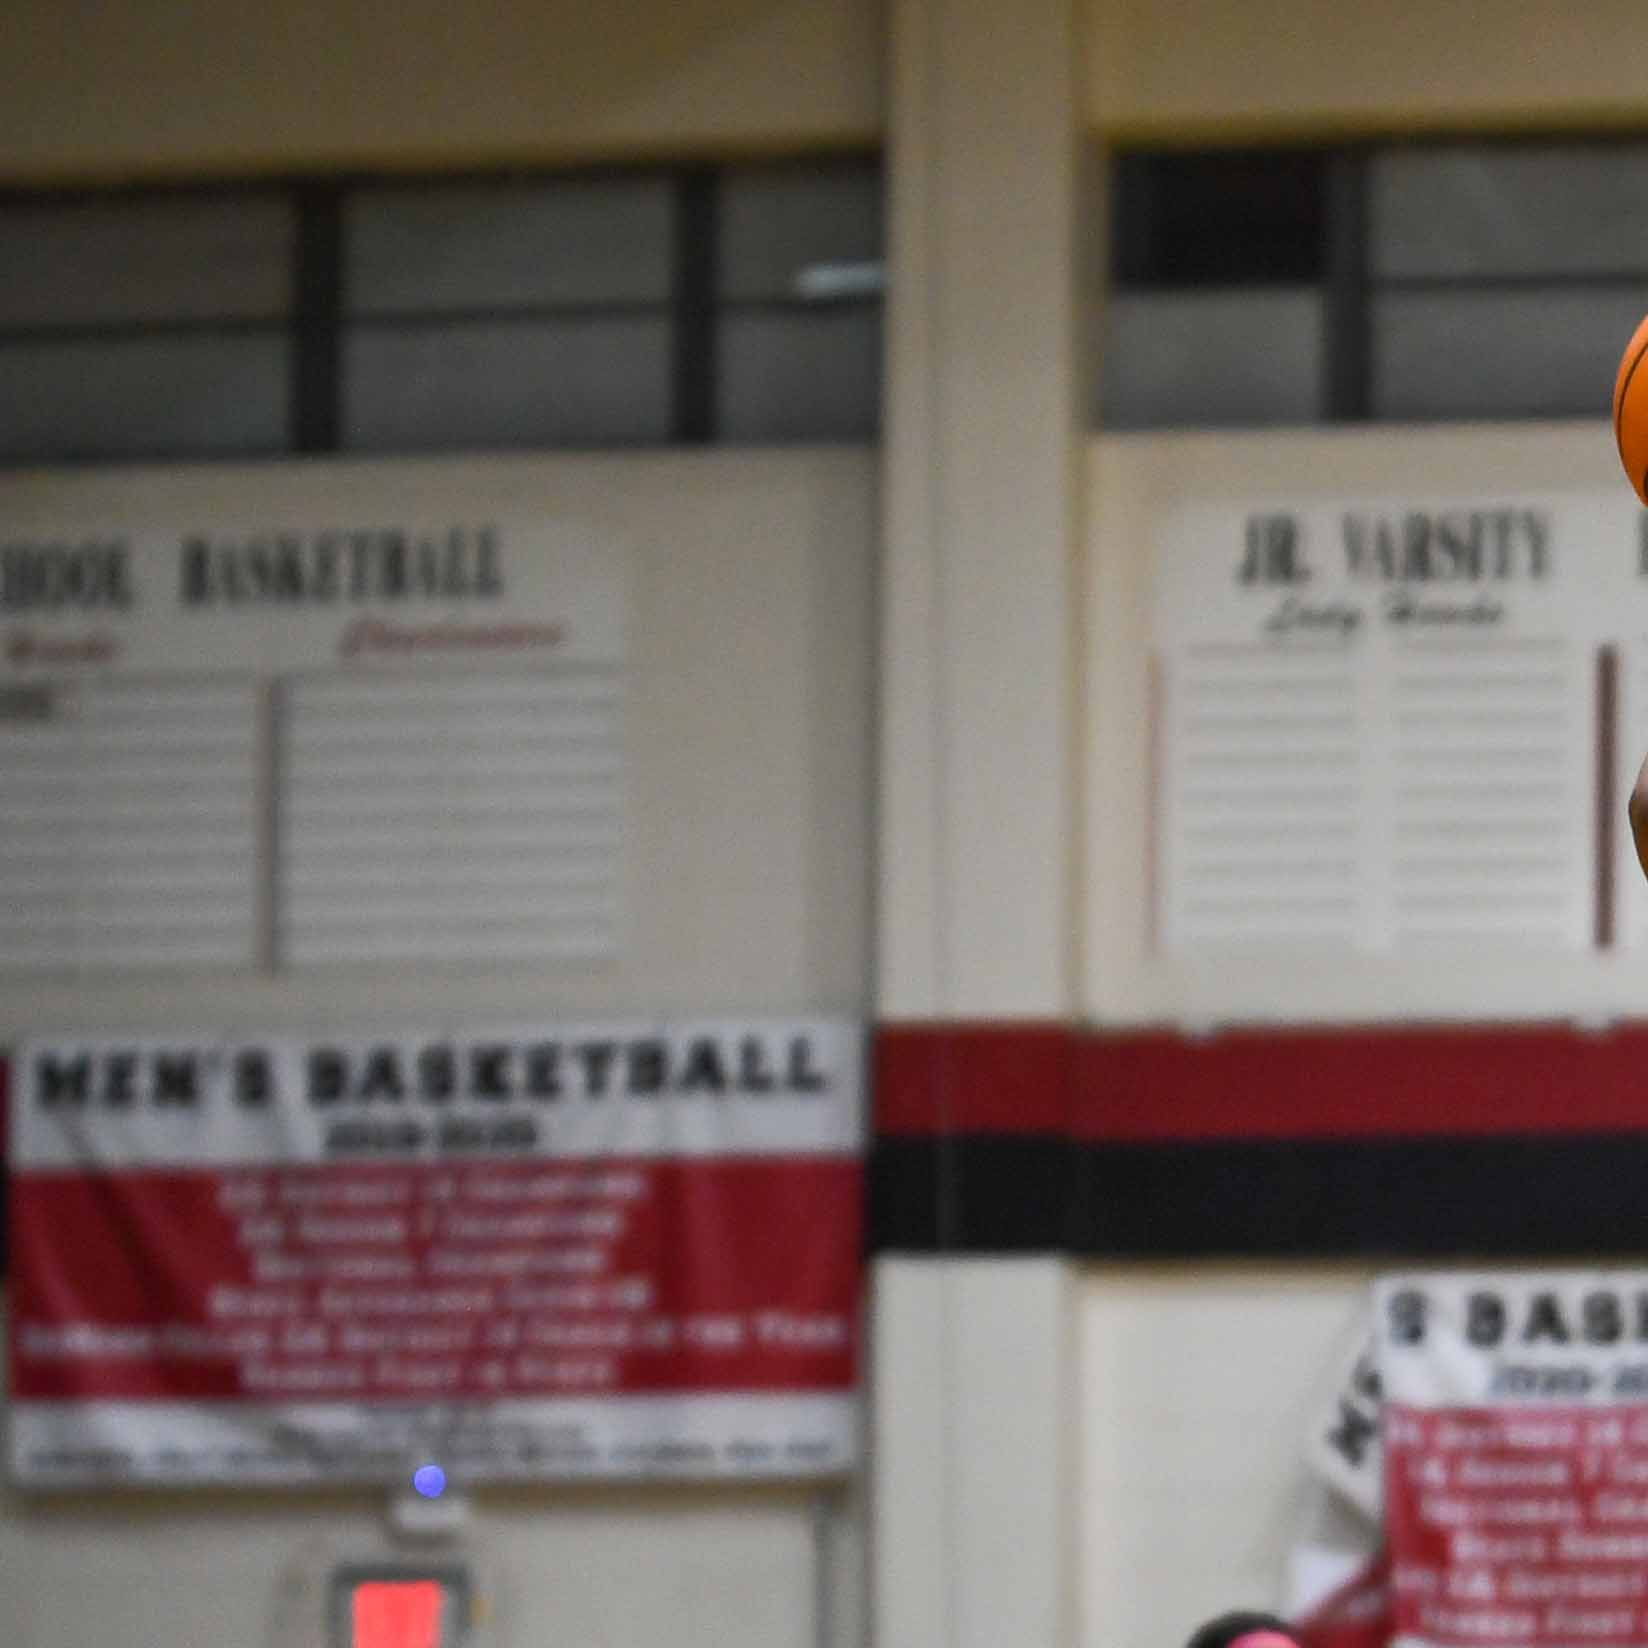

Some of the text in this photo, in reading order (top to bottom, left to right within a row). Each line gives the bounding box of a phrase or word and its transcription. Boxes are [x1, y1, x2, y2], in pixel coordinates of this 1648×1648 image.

[178, 523, 504, 605] BASKETBALL
[1342, 508, 1551, 584] VARSITY
[37, 1035, 827, 1111] MEN'S BASKETBALL
